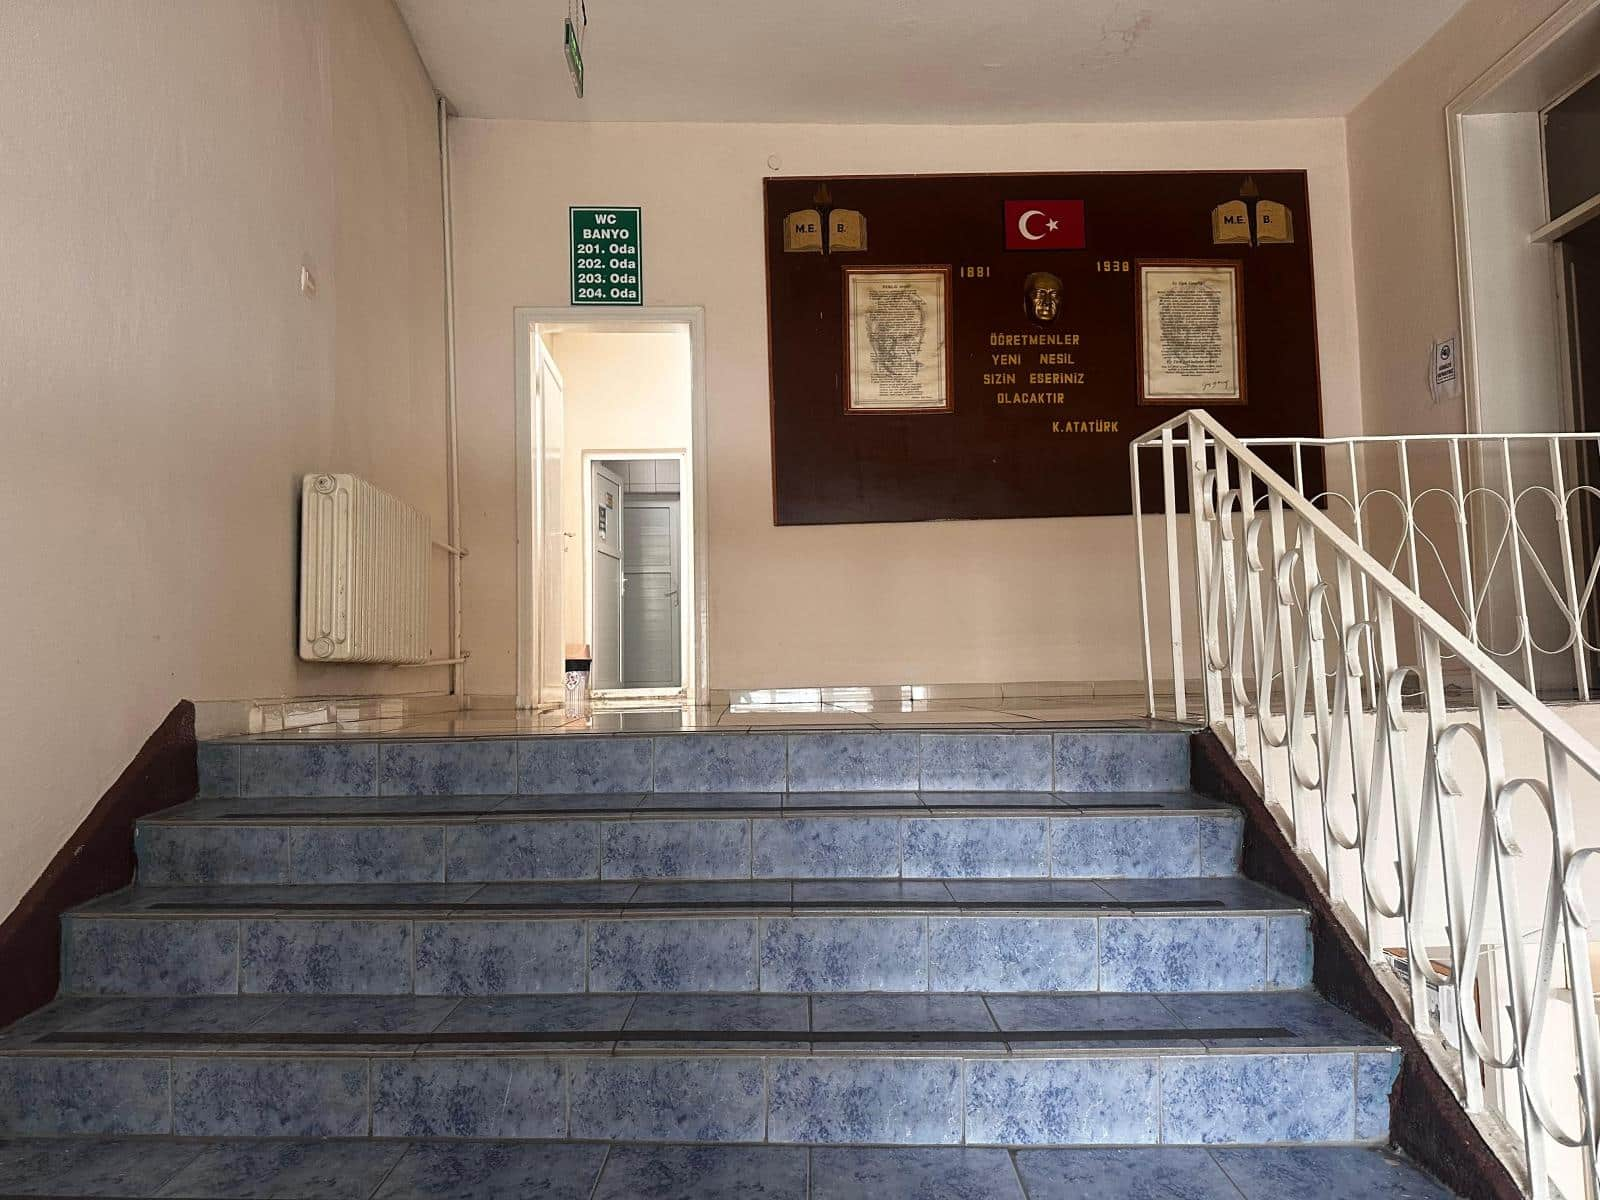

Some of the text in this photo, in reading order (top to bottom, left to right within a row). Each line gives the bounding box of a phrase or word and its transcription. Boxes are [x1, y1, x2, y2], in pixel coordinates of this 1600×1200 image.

[595, 214, 617, 224] WC
[583, 229, 629, 239] BANYO
[577, 244, 635, 254] 201. Oda
[577, 259, 636, 269] 202. Oda
[1096, 261, 1129, 272] 1938
[960, 266, 990, 278] 1881
[578, 273, 636, 283] 203. Oda
[578, 288, 637, 298] 204. Oda
[997, 392, 1065, 404] OLACAKTIR
